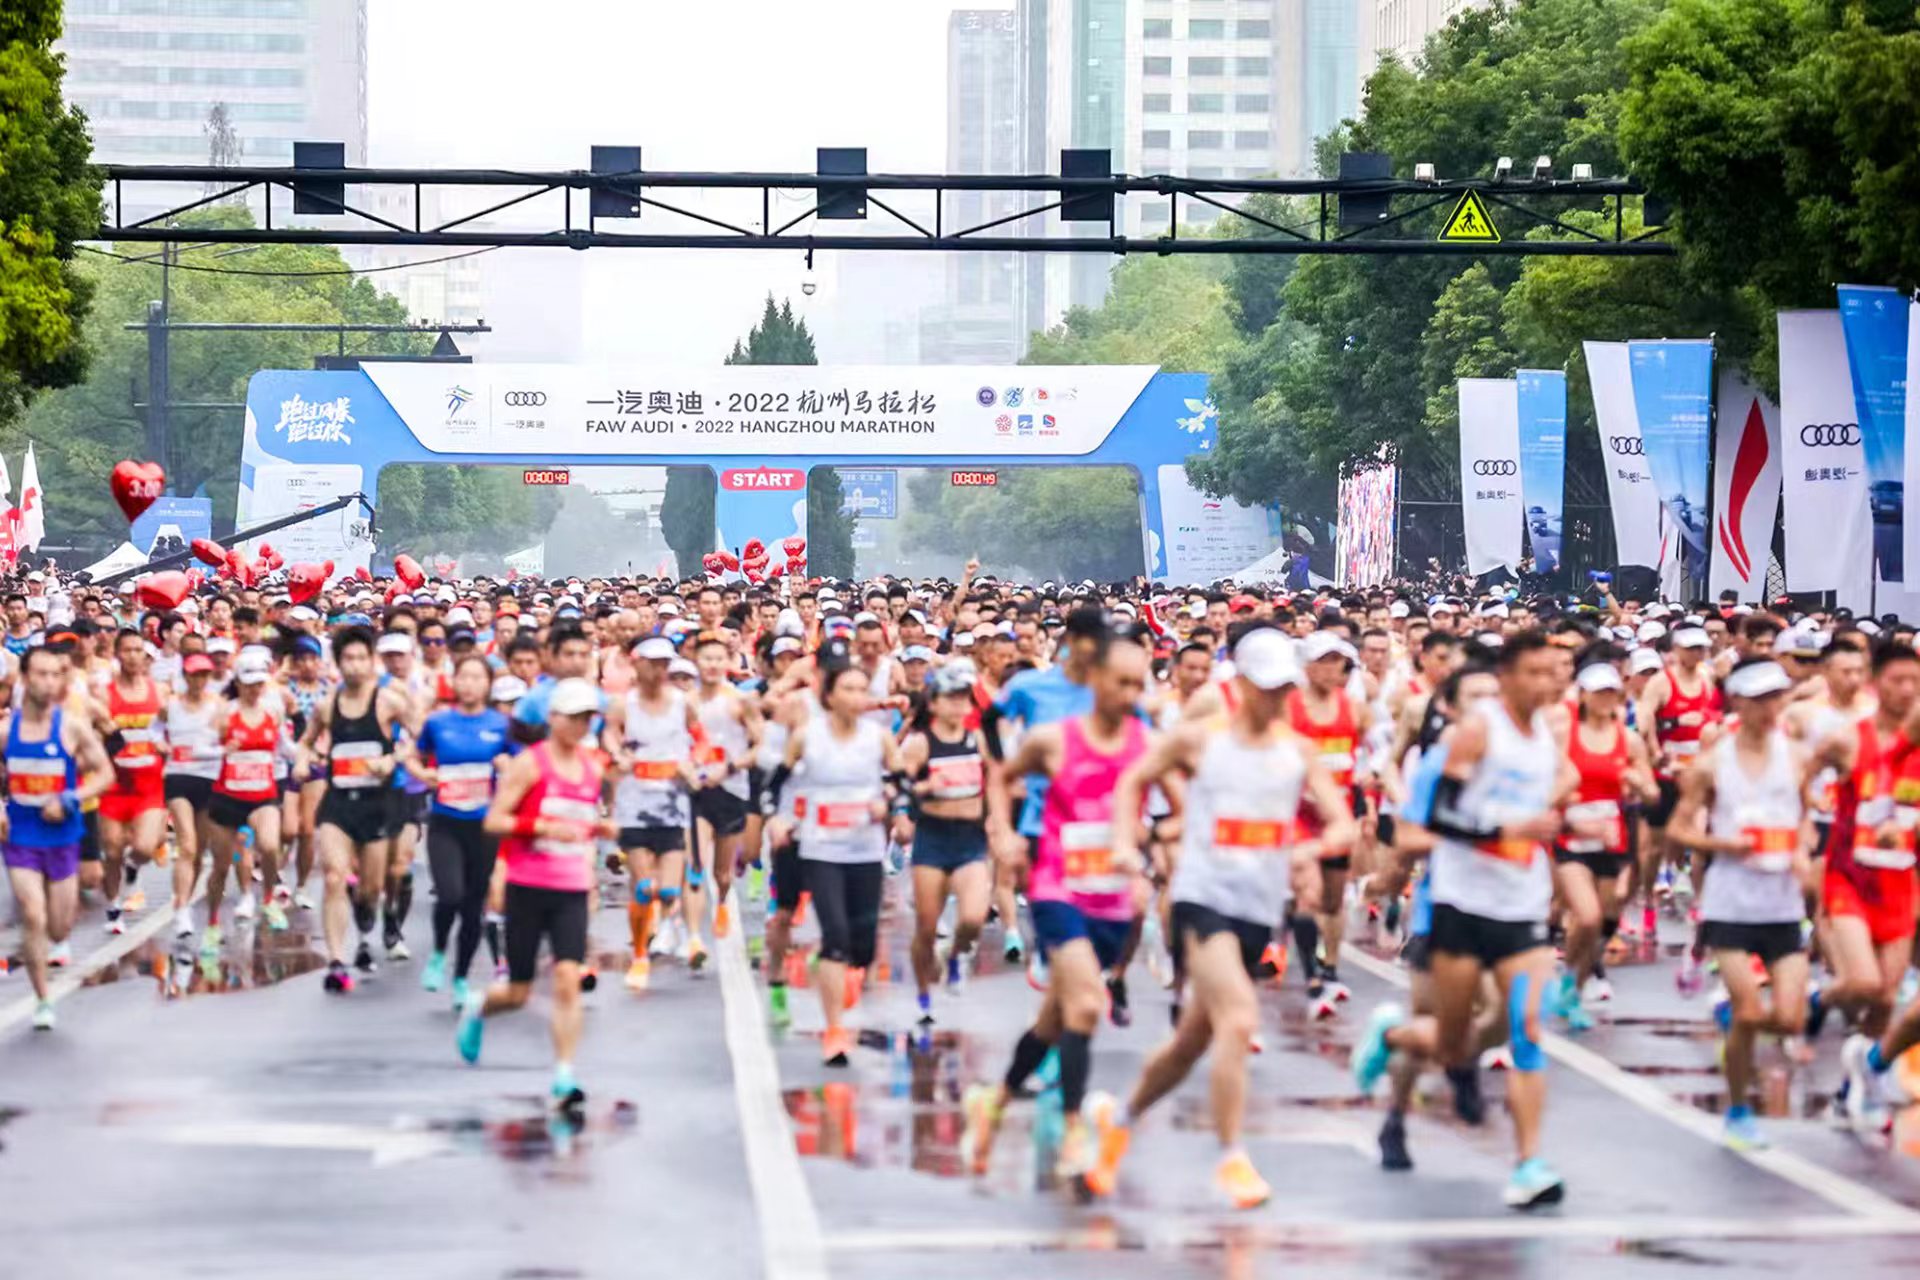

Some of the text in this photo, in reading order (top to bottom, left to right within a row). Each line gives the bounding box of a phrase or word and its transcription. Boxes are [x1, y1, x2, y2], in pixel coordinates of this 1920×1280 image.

[586, 388, 936, 415] 一汽奥迪 2022 杭州马拉松
[586, 420, 935, 433] FAW AUDI 2022 HANGZHOU MARATHON
[732, 473, 794, 487] START
